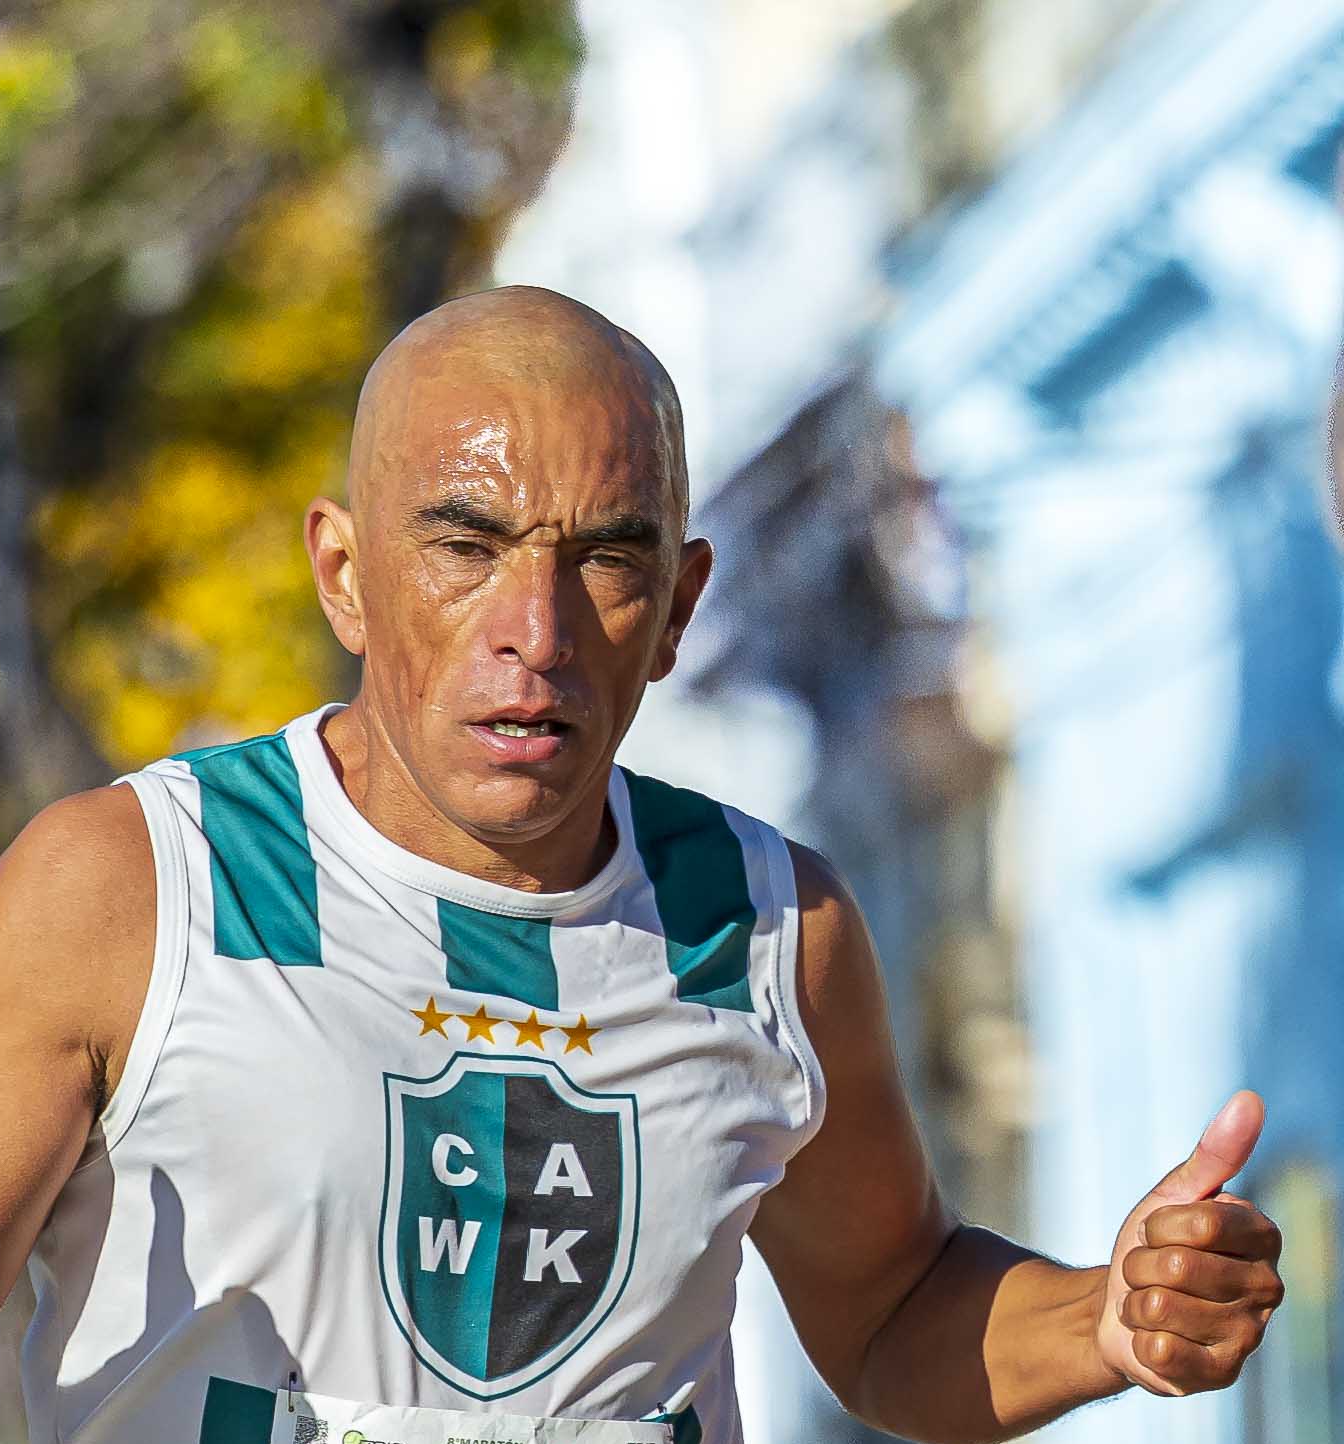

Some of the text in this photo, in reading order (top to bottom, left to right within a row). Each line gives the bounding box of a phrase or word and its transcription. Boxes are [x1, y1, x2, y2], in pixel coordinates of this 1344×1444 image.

[431, 1133, 594, 1197] C A
[418, 1216, 589, 1284] W K
